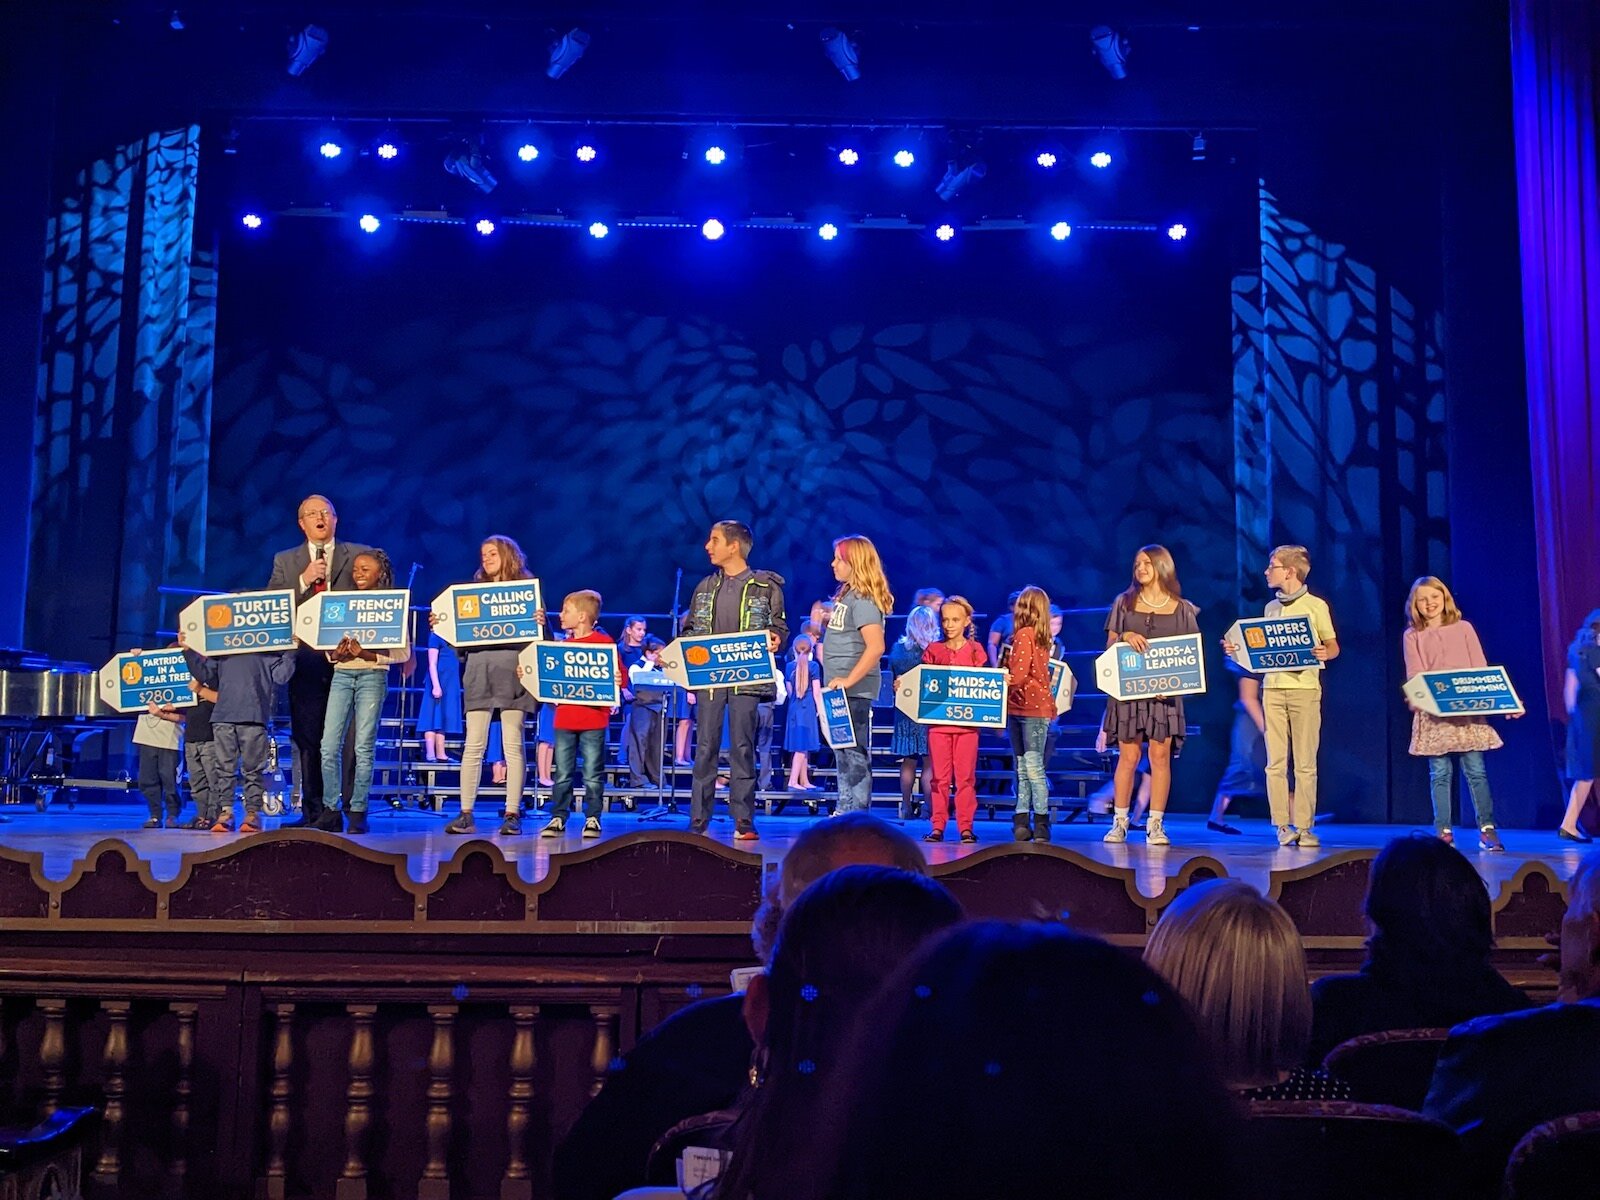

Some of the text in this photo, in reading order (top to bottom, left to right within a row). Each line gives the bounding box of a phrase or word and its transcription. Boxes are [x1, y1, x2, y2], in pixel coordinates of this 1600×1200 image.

[481, 591, 534, 604] CALLING
[233, 599, 289, 614] TURTLE
[327, 605, 340, 619] 3
[349, 599, 403, 611] FRENCH
[462, 600, 473, 613] 4
[491, 604, 527, 617] BIRDS
[234, 612, 290, 627] DOVES
[357, 611, 394, 623] HENS
[473, 623, 516, 638] $600
[1265, 622, 1307, 635] PIPERS
[223, 632, 270, 647] $600
[1250, 632, 1262, 644] 11
[1268, 634, 1311, 648] PIPING
[710, 641, 766, 654] GEESE-A-
[1144, 645, 1196, 659] LORDS-A-
[143, 656, 187, 667] PARTRIDG
[546, 656, 555, 670] 5
[564, 651, 608, 665] GOLD
[717, 650, 763, 663] LAYING
[1125, 655, 1137, 668] 10
[1146, 655, 1197, 670] LEAPING
[1260, 653, 1300, 667] $3,021
[128, 664, 135, 680] 1
[158, 665, 176, 675] IN A
[564, 665, 610, 679] RINGS
[709, 668, 750, 683] $720
[144, 672, 191, 685] PEAR TREE
[948, 676, 1003, 688] MAIDS-A-
[1125, 675, 1180, 693] $13,980
[1451, 675, 1503, 685] DRUMMERS
[552, 684, 595, 699] $1,245
[928, 679, 939, 693] 8
[1455, 683, 1508, 693] DRUMMING
[139, 689, 174, 703] $280
[948, 688, 1001, 700] MILKING
[946, 706, 974, 720] $58
